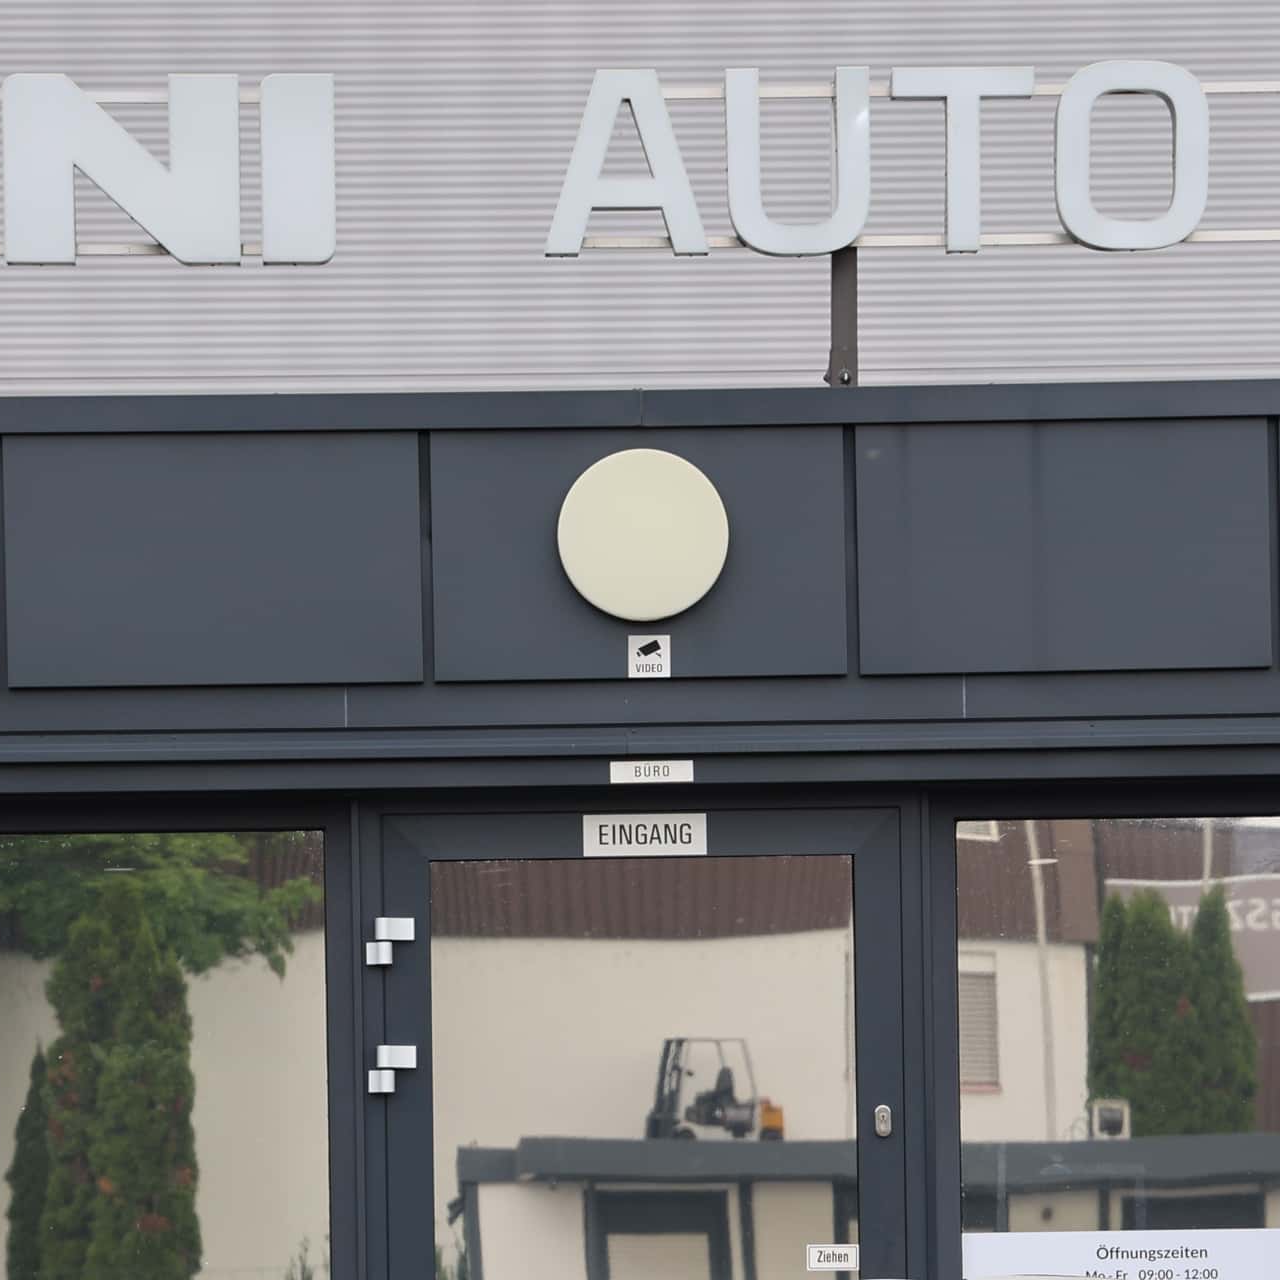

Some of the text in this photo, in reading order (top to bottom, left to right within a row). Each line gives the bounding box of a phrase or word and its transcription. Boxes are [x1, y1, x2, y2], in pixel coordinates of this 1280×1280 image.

[543, 59, 1213, 256] AUTO
[635, 663, 663, 673] VIDEO
[634, 763, 671, 778] BÜRO
[598, 822, 693, 846] EINGANG
[816, 1249, 849, 1263] Ziehen
[1096, 1244, 1209, 1262] Öffnungszeiten
[1116, 1270, 1129, 1280] Fr
[1138, 1269, 1174, 1280] 09:00
[1184, 1268, 1219, 1280] 12:00
